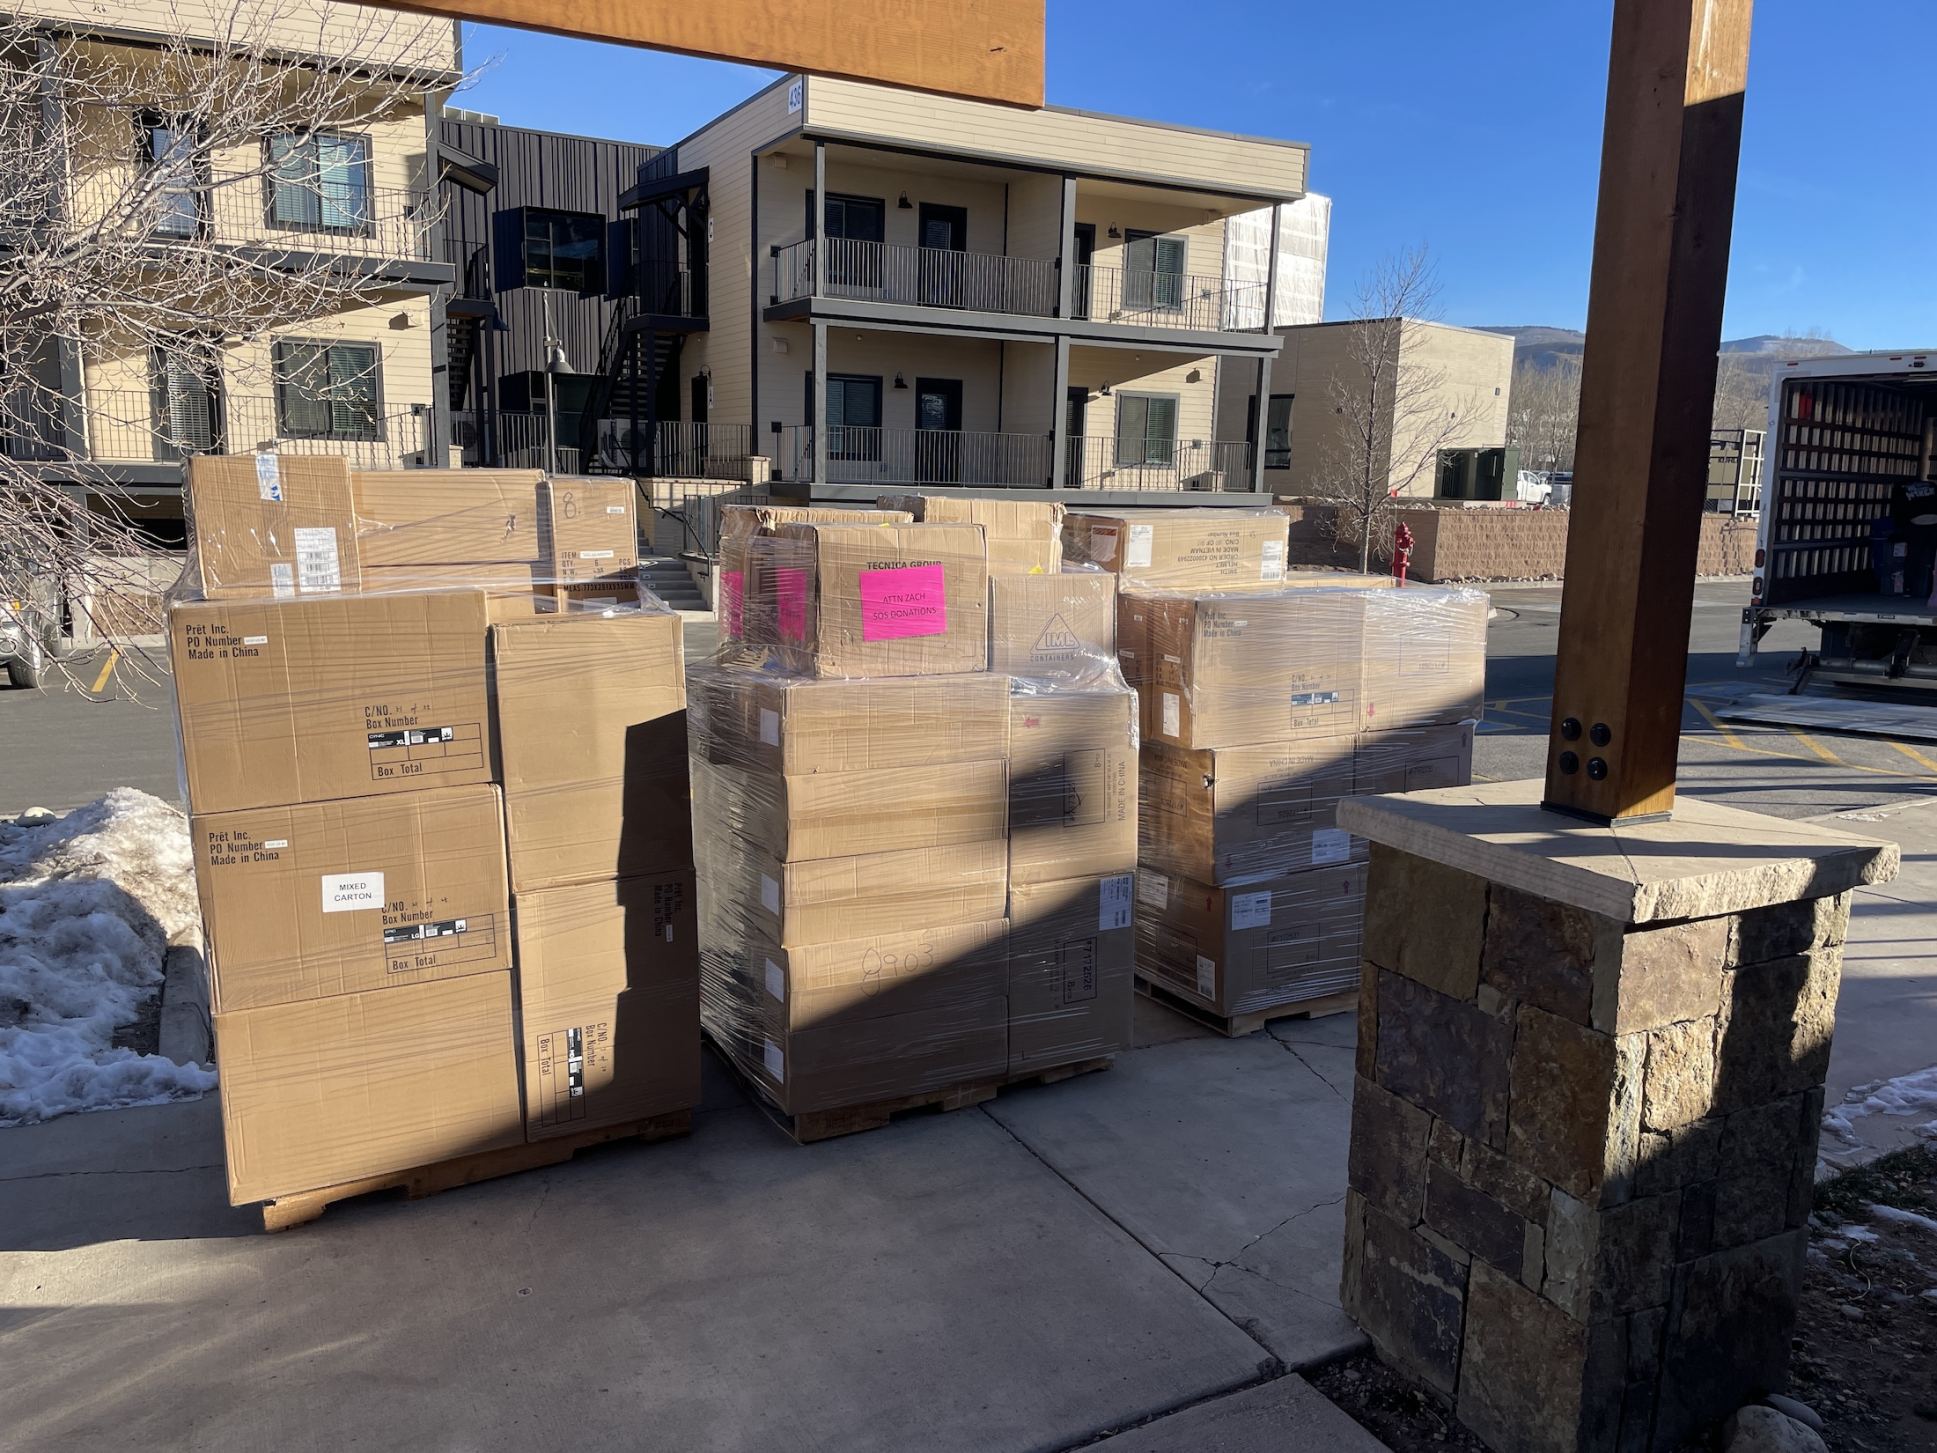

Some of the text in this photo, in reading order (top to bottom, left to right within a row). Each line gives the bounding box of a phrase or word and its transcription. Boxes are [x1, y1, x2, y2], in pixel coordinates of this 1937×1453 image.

[867, 561, 907, 570] TECNICA
[883, 593, 926, 604] ATTN ZACH
[873, 607, 937, 621] SOS DONATIONS
[186, 624, 229, 635] Prêt Inc.
[187, 637, 200, 648] PO
[205, 635, 242, 647] Number
[1045, 632, 1075, 647] IML
[188, 646, 259, 660] Made in China
[364, 705, 393, 718] C/NO.
[366, 716, 419, 730] Box Number
[378, 763, 422, 777] Box Total
[1118, 761, 1126, 821] MADE IN CHINA
[233, 831, 251, 841] Inc.
[210, 843, 222, 854] PO
[227, 841, 263, 853] Number
[211, 851, 279, 866] Made in China
[339, 882, 367, 891] MIXED
[334, 892, 372, 902] CARTON
[382, 910, 434, 925] Box Number
[392, 956, 436, 971] Box Total
[585, 1024, 598, 1067] Box Number
[540, 1038, 551, 1076] Box Total
